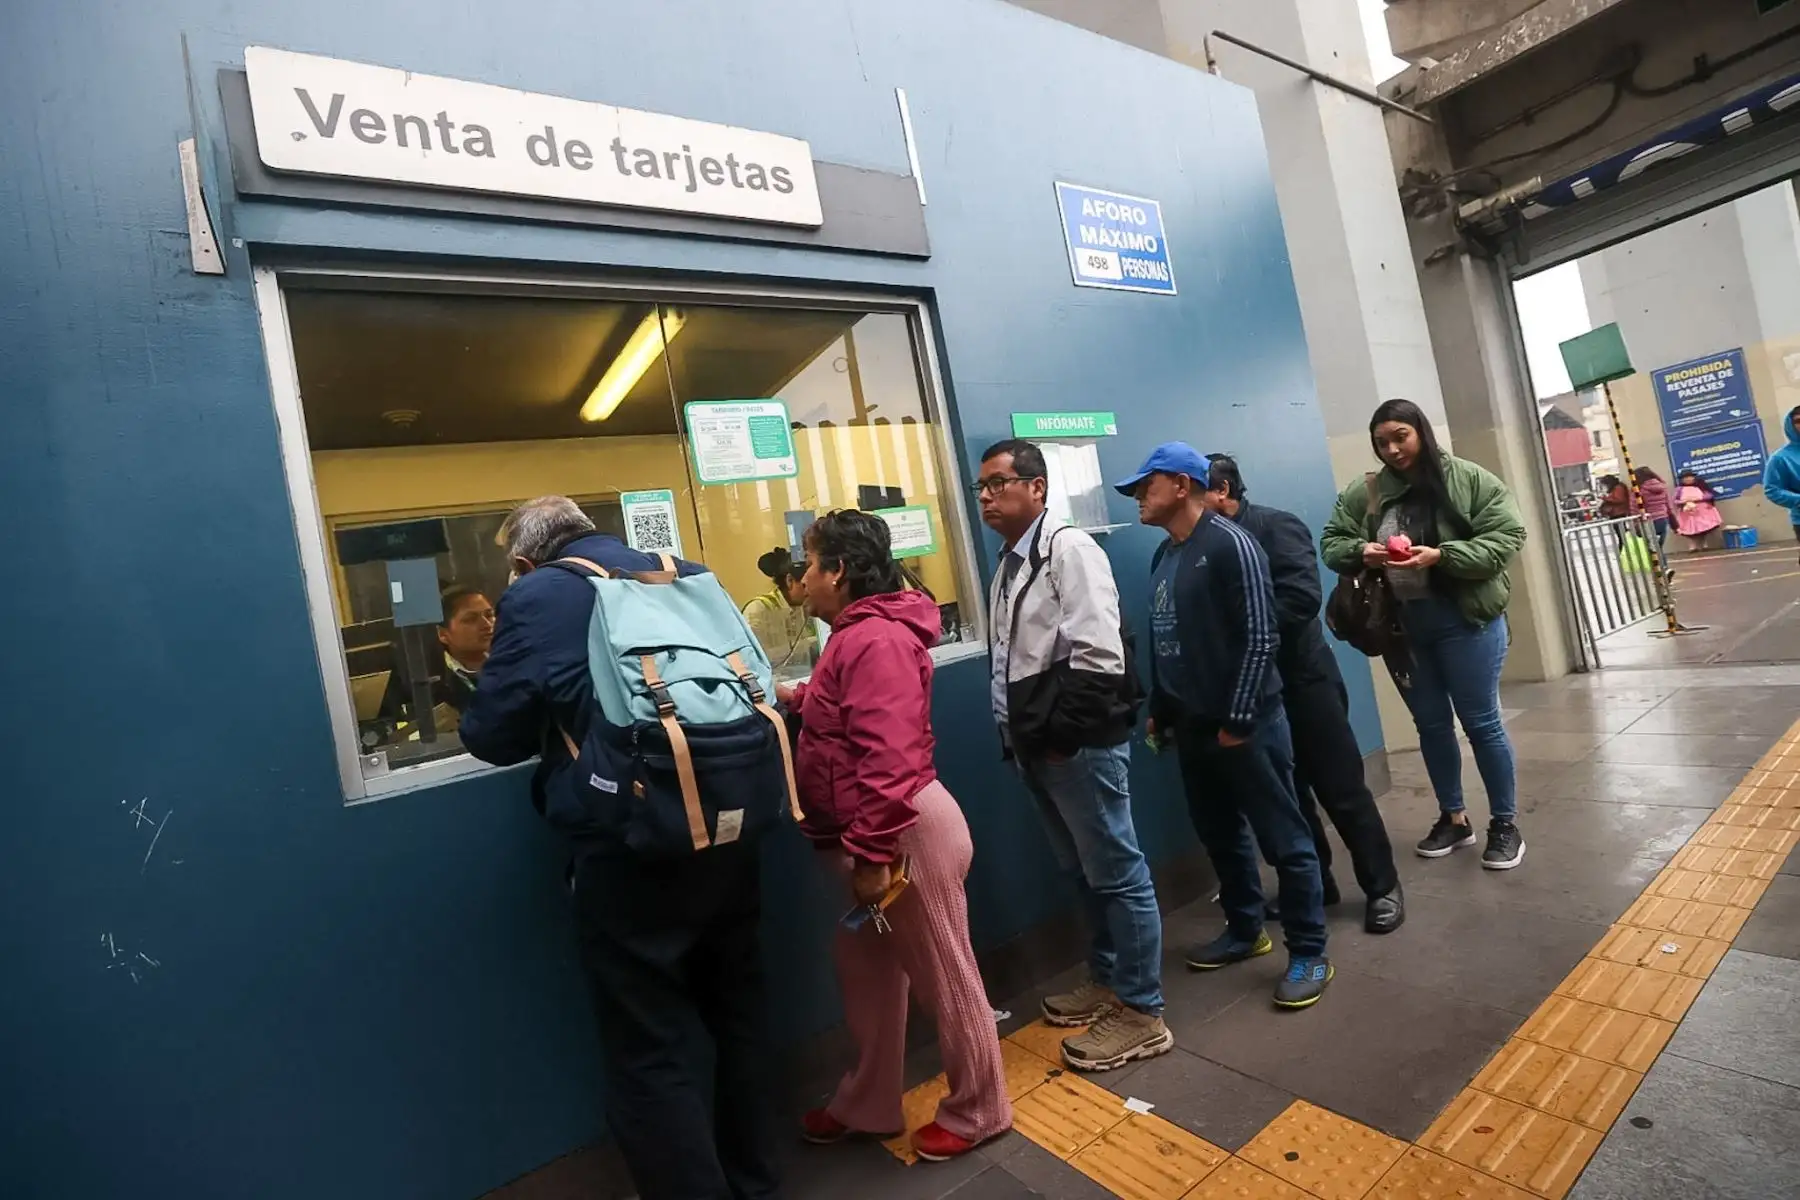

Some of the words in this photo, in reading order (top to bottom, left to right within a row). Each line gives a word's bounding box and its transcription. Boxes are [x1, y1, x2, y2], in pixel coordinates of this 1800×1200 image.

[294, 87, 496, 158] Venta
[526, 125, 593, 171] de
[609, 136, 795, 194] tarjetas
[1082, 198, 1146, 225] AFORO
[1079, 222, 1157, 253] MÁXIMO
[1087, 255, 1109, 271] 498
[1121, 257, 1169, 282] PERSONAS
[1664, 359, 1733, 383] PROHIBIDA
[1666, 374, 1716, 392] REVENTA
[1717, 368, 1734, 380] DE
[1678, 380, 1725, 398] PASAJES
